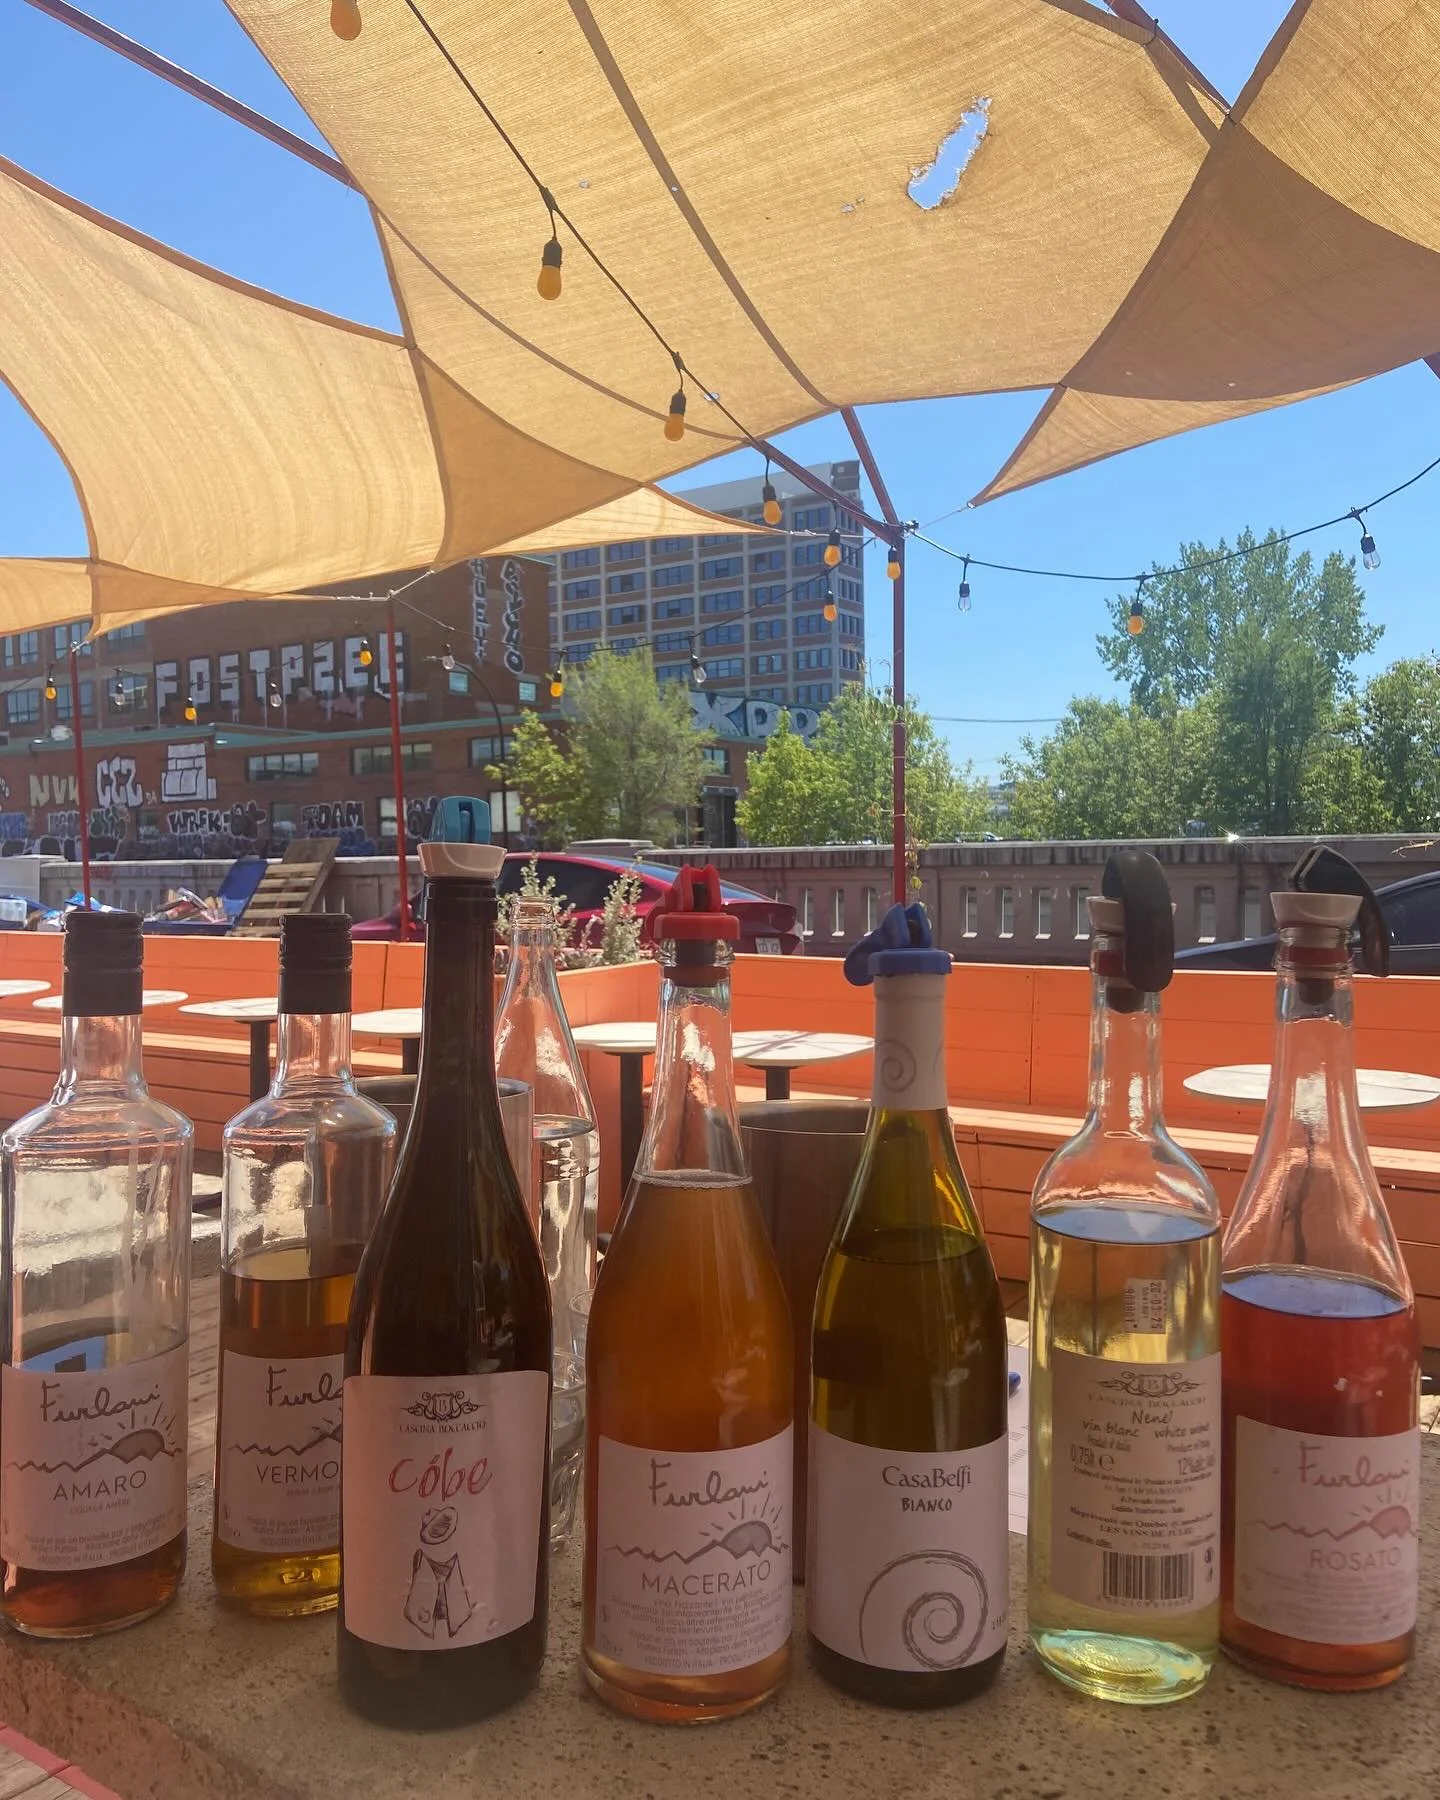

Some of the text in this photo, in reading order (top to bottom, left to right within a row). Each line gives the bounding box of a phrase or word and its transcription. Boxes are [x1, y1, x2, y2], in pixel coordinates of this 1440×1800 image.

[40, 1380, 160, 1423] Furlani
[1106, 1421, 1139, 1437] blanc
[1154, 1424, 1186, 1438] white
[881, 1464, 973, 1492] CasaBelfi
[1298, 1440, 1411, 1488] Furlani
[53, 1469, 147, 1501] AMARO
[649, 1458, 769, 1507] Furlani
[901, 1497, 953, 1512] BIANCO
[1310, 1546, 1402, 1571] ROSATO
[641, 1559, 771, 1596] MACERATO
